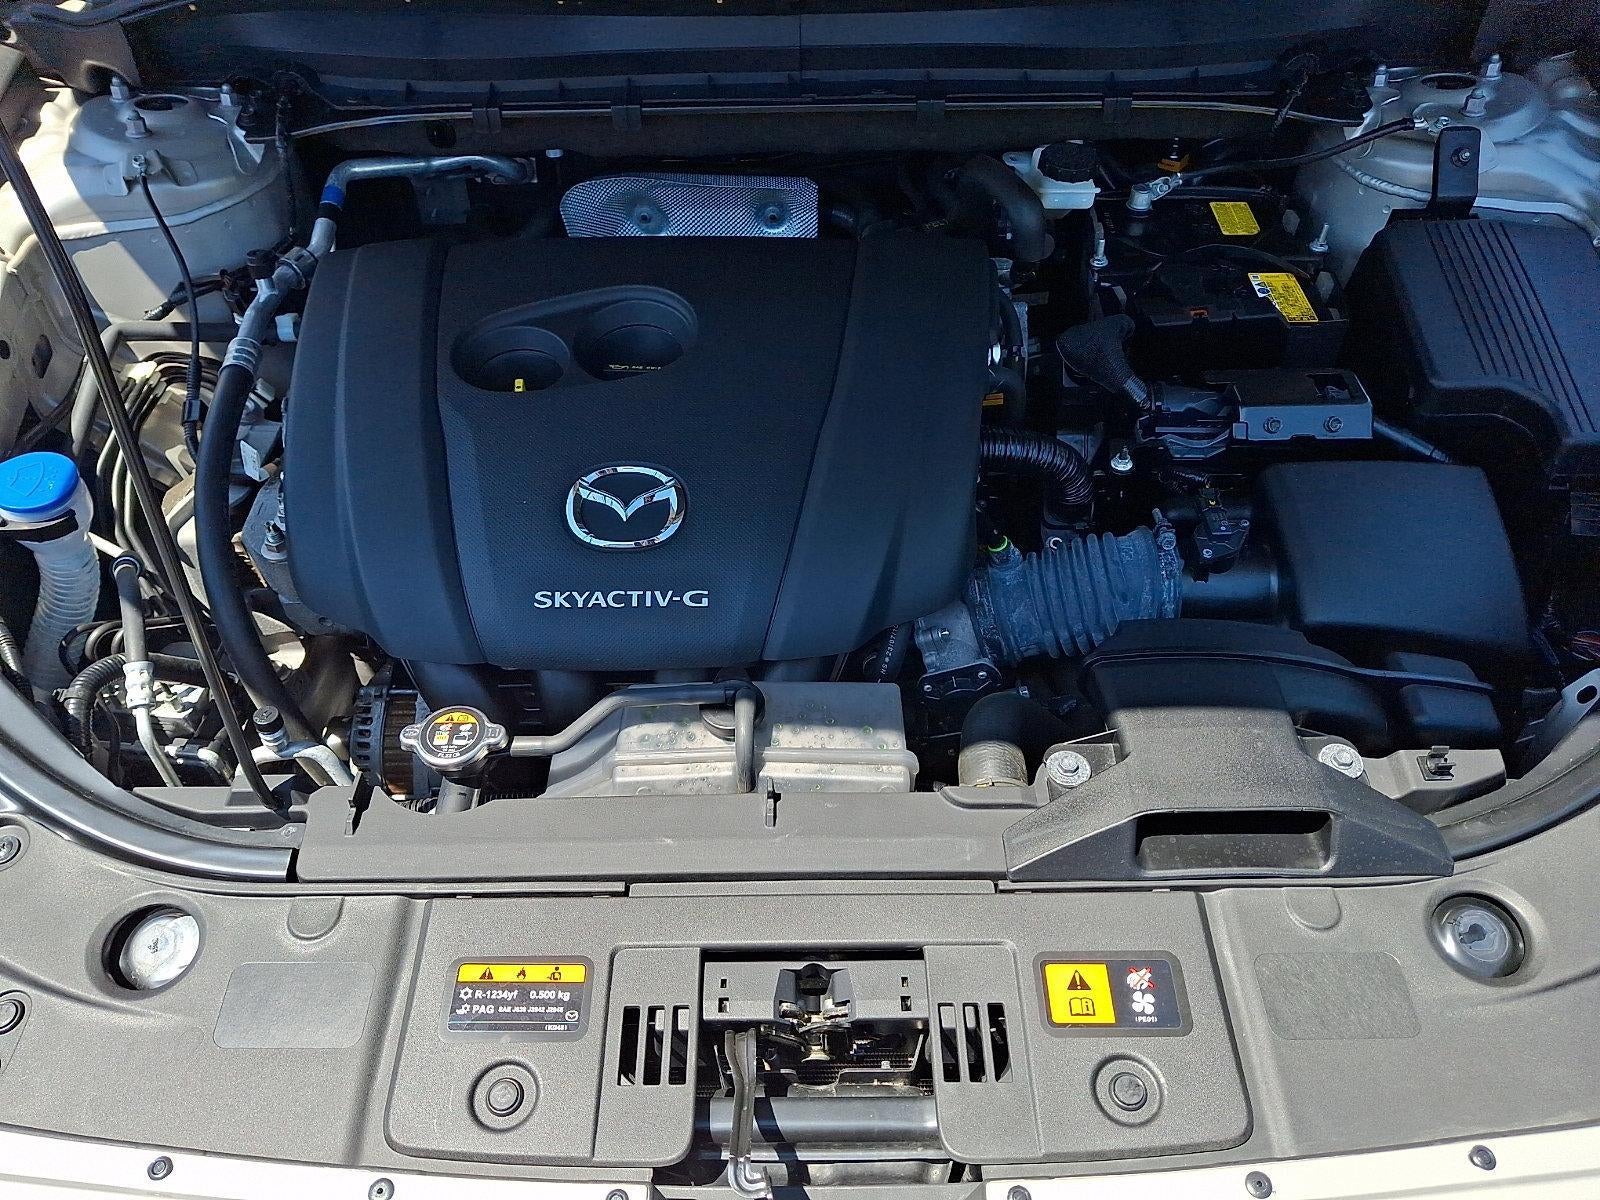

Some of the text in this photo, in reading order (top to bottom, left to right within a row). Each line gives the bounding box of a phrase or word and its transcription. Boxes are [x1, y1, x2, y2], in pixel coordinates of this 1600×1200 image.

[533, 590, 709, 609] SKYACTIV-G
[474, 989, 571, 1002] R-1234yf 0.500 kg
[472, 1004, 495, 1014] PAG
